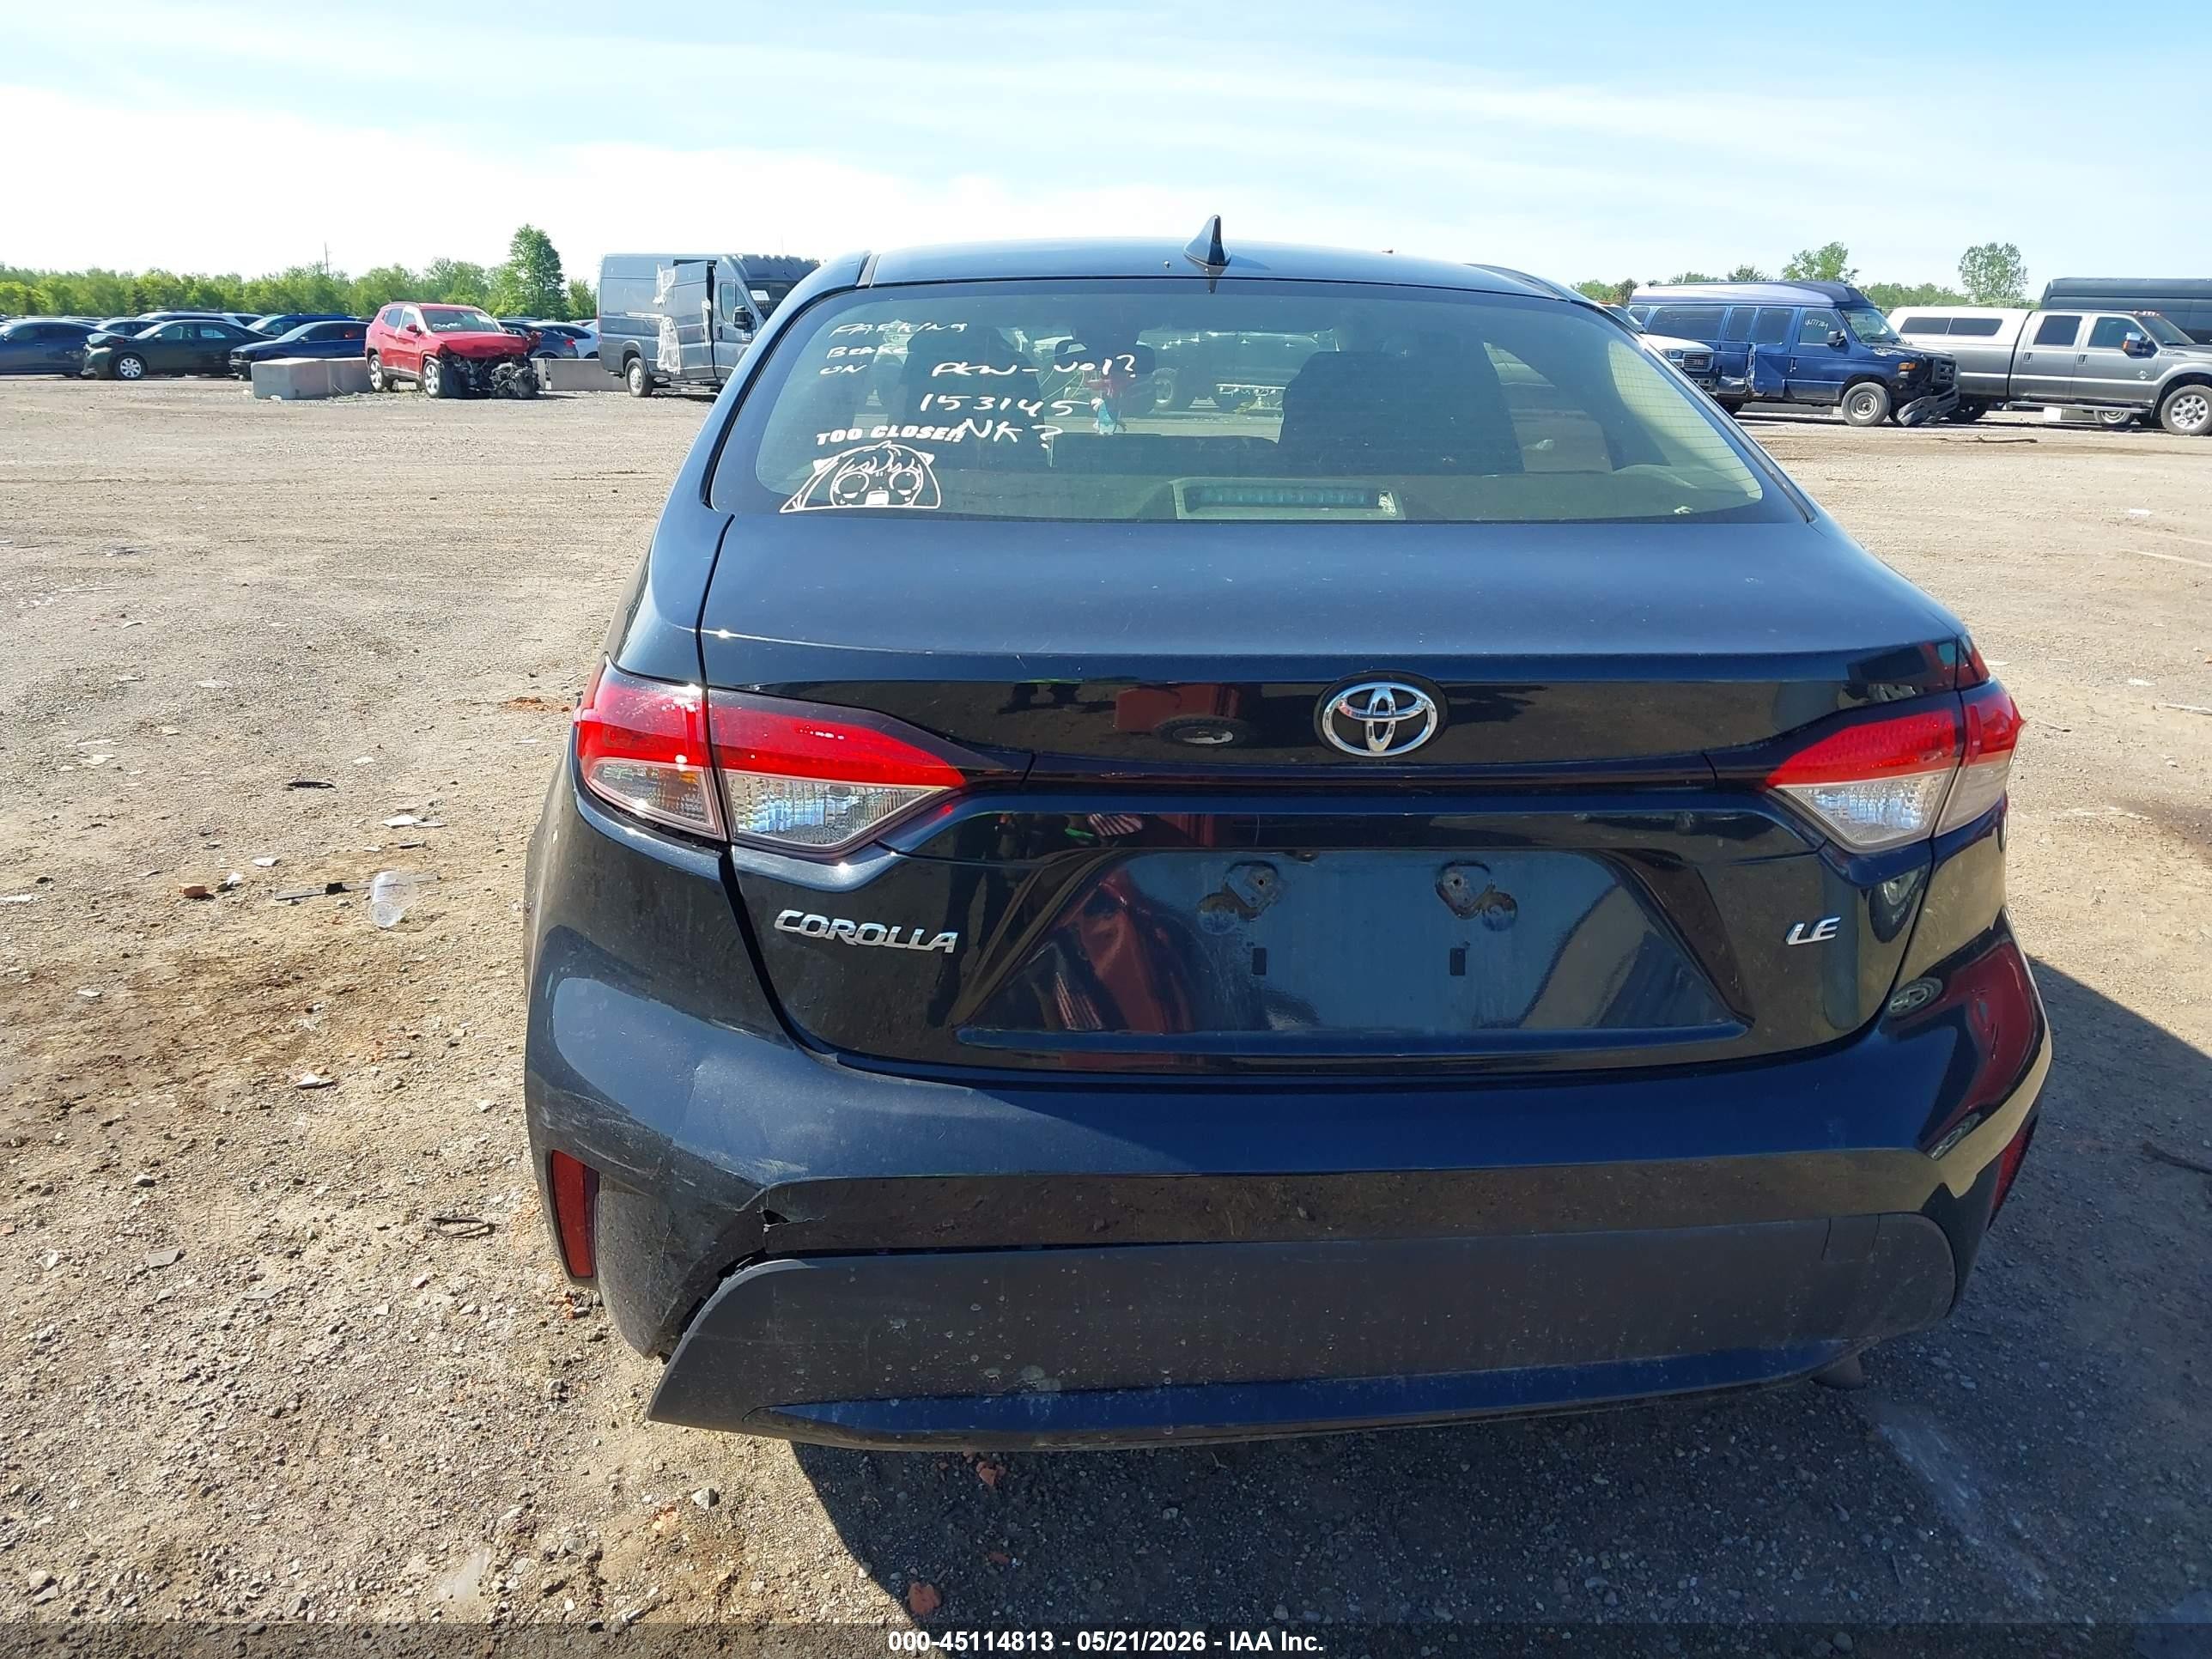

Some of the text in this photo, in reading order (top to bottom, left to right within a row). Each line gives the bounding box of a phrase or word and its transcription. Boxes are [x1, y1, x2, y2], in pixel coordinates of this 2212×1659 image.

[817, 431, 862, 446] TOO
[775, 909, 958, 953] COROLLA
[1786, 916, 1841, 945] LE
